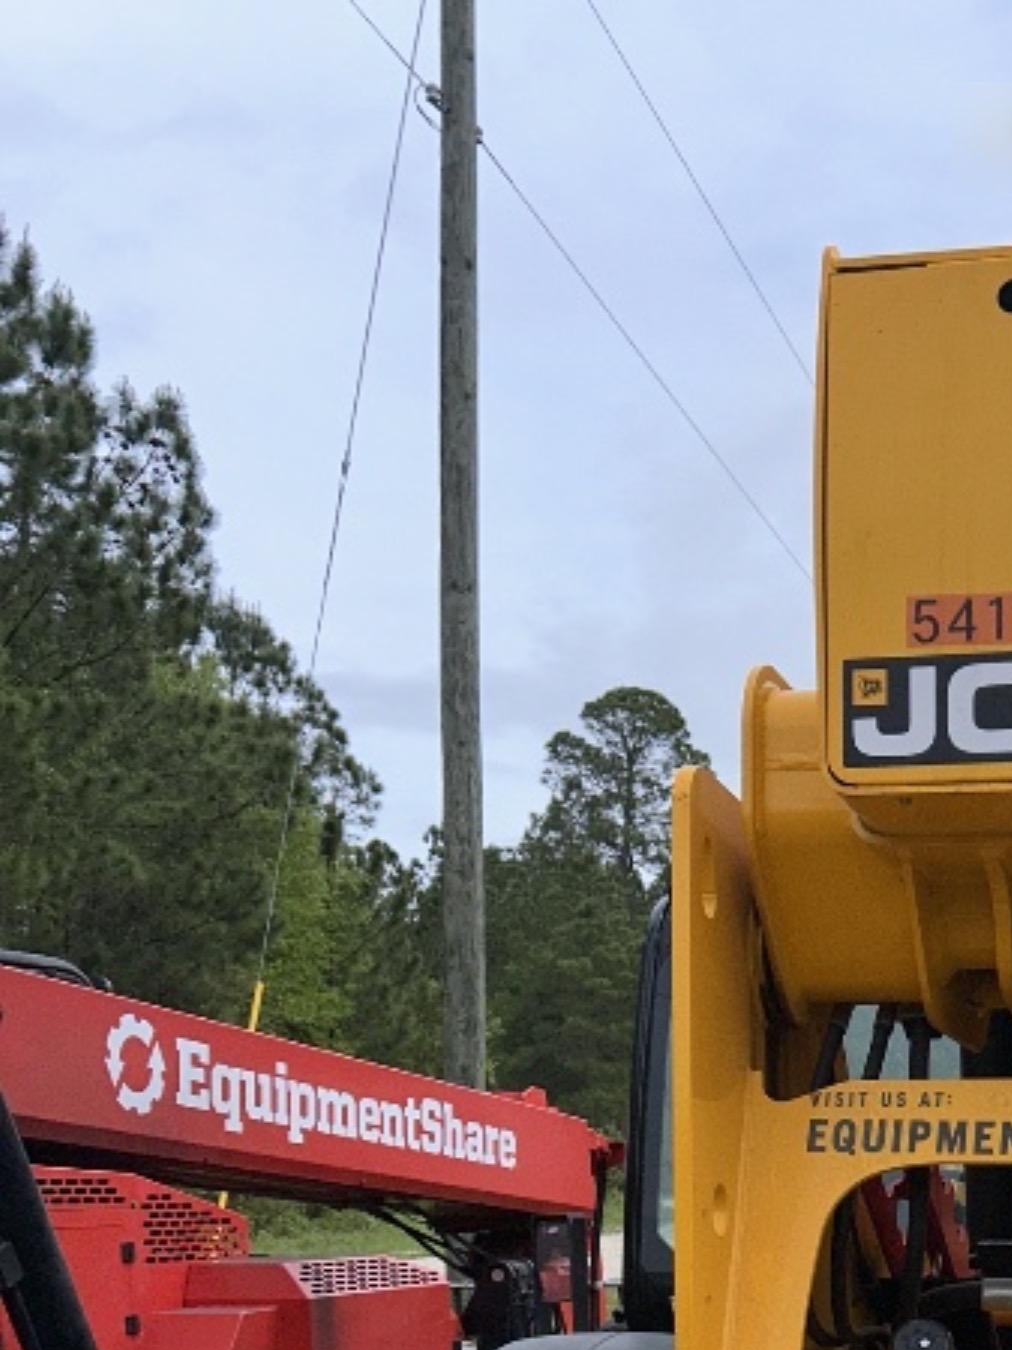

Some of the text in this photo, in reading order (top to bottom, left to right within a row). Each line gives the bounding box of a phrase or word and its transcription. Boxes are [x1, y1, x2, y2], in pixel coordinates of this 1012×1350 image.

[175, 1037, 517, 1169] EquipmentShare
[810, 1091, 953, 1108] VISIT US AT:
